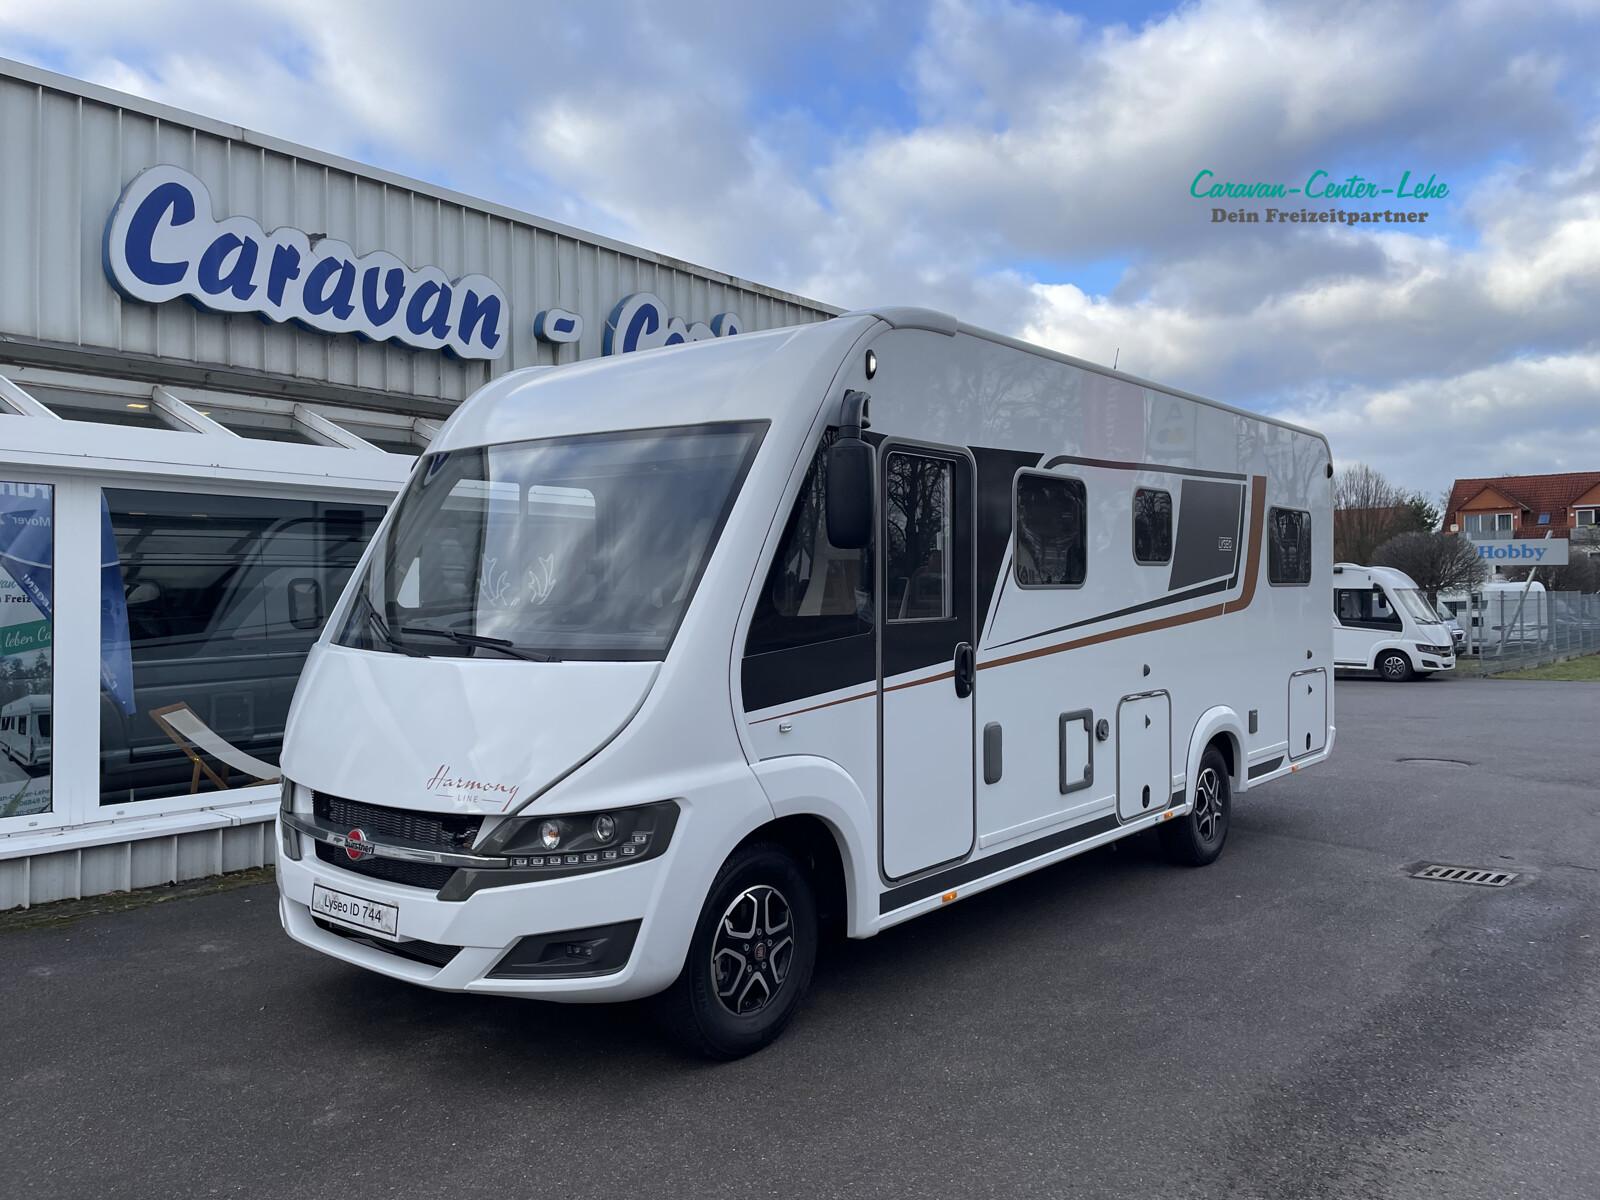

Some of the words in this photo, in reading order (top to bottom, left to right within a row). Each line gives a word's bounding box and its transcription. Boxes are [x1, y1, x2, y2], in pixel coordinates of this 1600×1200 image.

[124, 181, 501, 350] Caravan
[1477, 544, 1546, 561] Hobby
[5, 631, 33, 648] leben
[426, 764, 520, 812] Harmony
[457, 794, 479, 803] LINE
[324, 895, 348, 912] Lyseo
[349, 902, 360, 916] ID
[362, 906, 382, 923] 744
